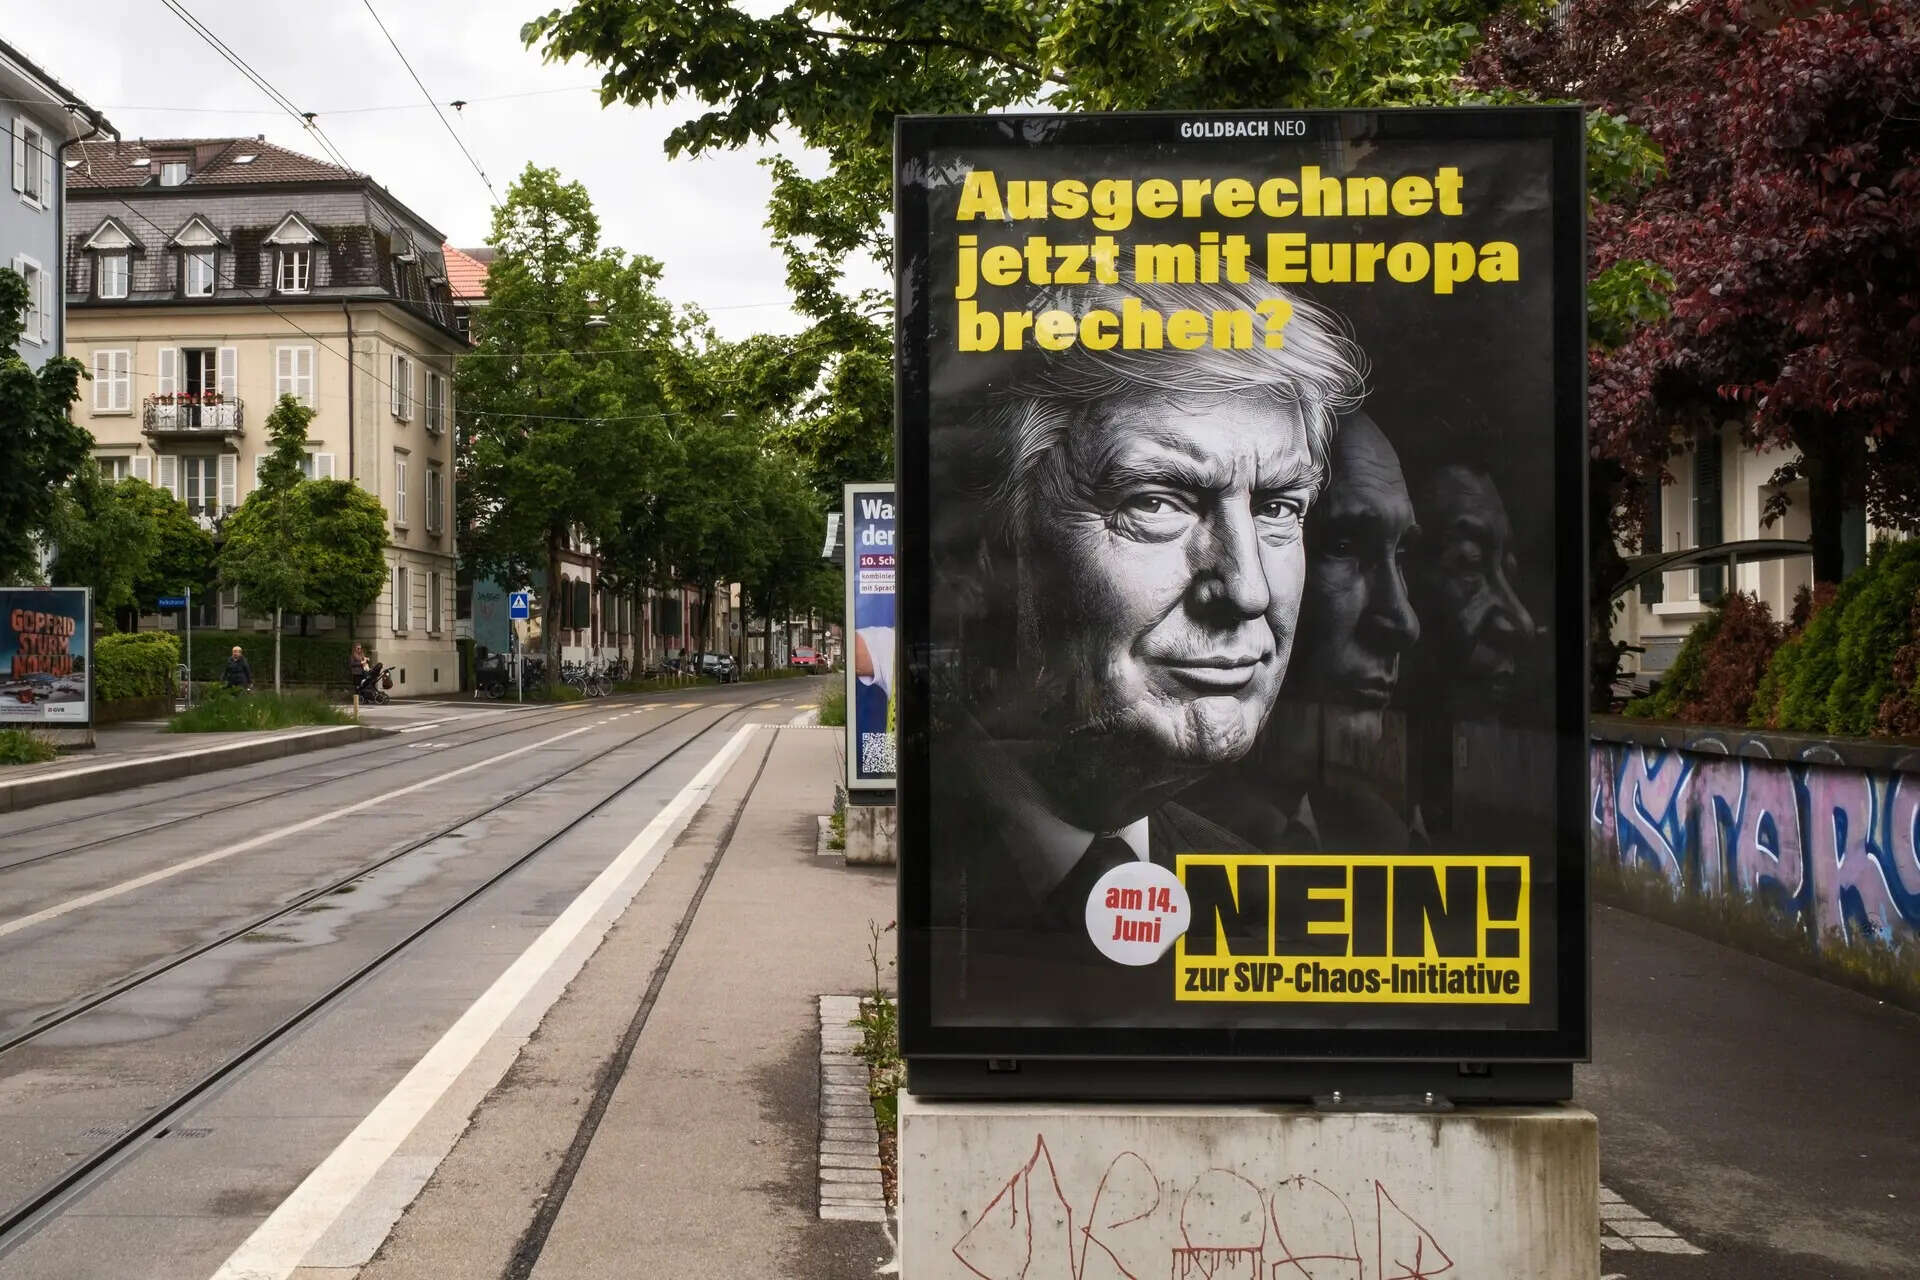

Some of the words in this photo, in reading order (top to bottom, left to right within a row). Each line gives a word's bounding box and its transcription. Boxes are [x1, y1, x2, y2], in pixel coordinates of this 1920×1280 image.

[1180, 120, 1269, 138] GOLDBACH
[1274, 120, 1306, 137] NEO
[955, 165, 1464, 232] Ausgerechnet
[954, 234, 1121, 300] jetzt
[1133, 231, 1252, 286] mit
[1266, 232, 1519, 295] Europa
[957, 296, 1293, 352] brechen?
[861, 499, 895, 520] Wa
[861, 557, 877, 566] 10.
[1104, 886, 1143, 910] am
[1147, 886, 1177, 913] 14.
[1184, 864, 1522, 958] NEIN!
[1112, 915, 1161, 944] Juni
[1184, 967, 1230, 992] zur
[1234, 961, 1520, 995] SVP-Chaos-Initiative
